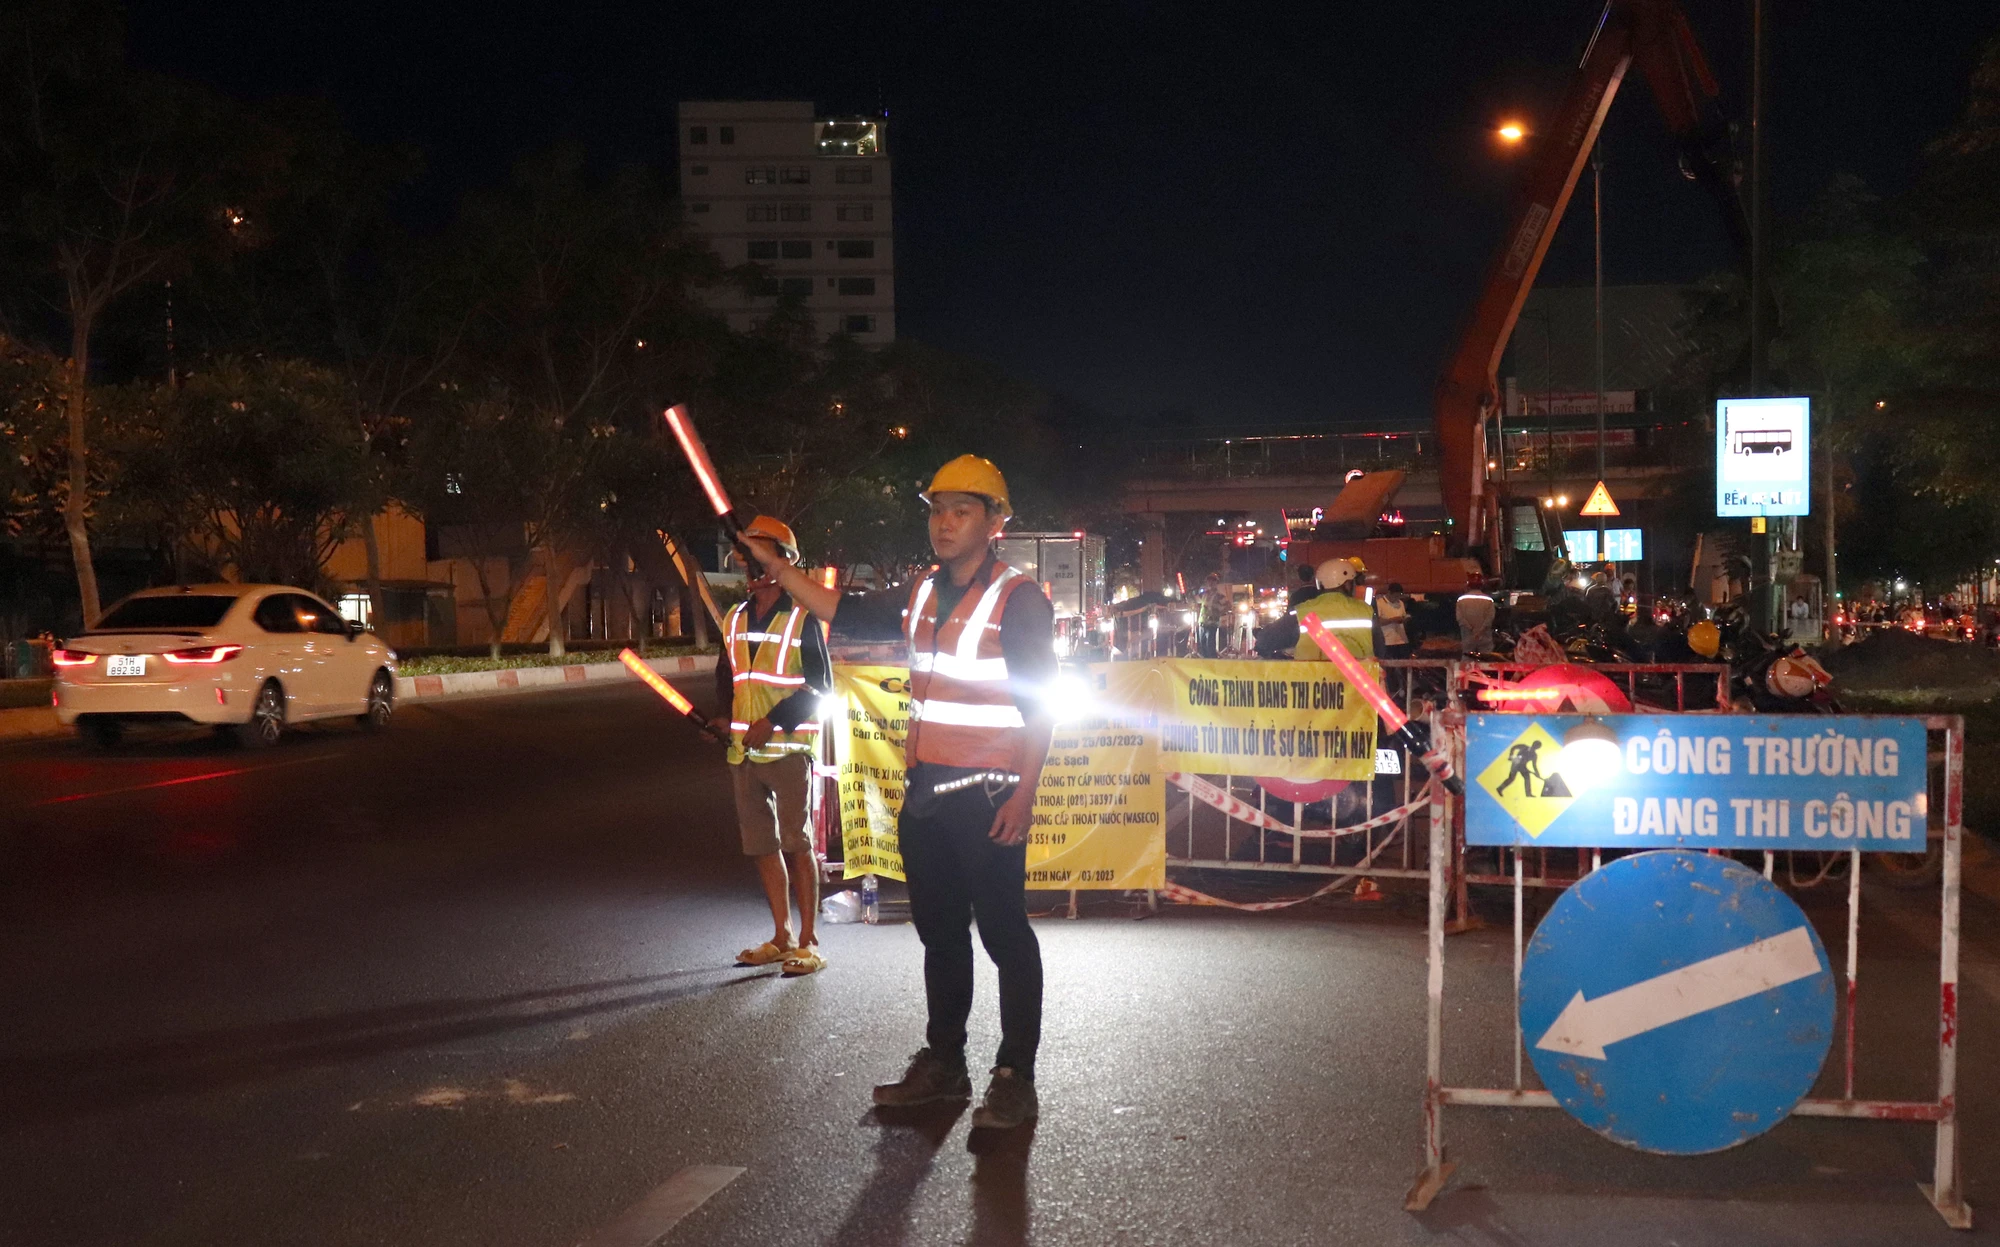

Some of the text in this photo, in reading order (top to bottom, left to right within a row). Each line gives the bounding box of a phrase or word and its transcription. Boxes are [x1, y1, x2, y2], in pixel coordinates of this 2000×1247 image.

[118, 658, 135, 666] 51H
[1189, 674, 1344, 710] CÔNG TRÌNH ĐANG THI CÔNG
[1162, 719, 1373, 764] CHÚNG TÔI XIN LỖI VỀ SỰ BẤT TIỆN NÀY
[1625, 728, 1899, 777] CÔNG TRƯỜNG
[1042, 774, 1065, 787] CÔNG
[1067, 775, 1076, 787] TY
[1078, 772, 1092, 786] CẤP
[1094, 772, 1117, 786] NƯỚC
[1133, 772, 1150, 785] GÒN
[1067, 794, 1088, 808] (028)
[854, 817, 868, 829] HUY
[1054, 811, 1069, 825] CẤP
[1072, 811, 1097, 825] THOÁT
[1099, 811, 1122, 824] NƯỚC
[1123, 812, 1159, 826] (WASECO)
[1613, 792, 1912, 840] ĐANG THI CÔNG
[1051, 833, 1066, 844] 419
[861, 854, 877, 867] GIAN
[878, 857, 888, 870] THI
[1032, 871, 1048, 882] 22H
[1050, 868, 1072, 882] NGÀY
